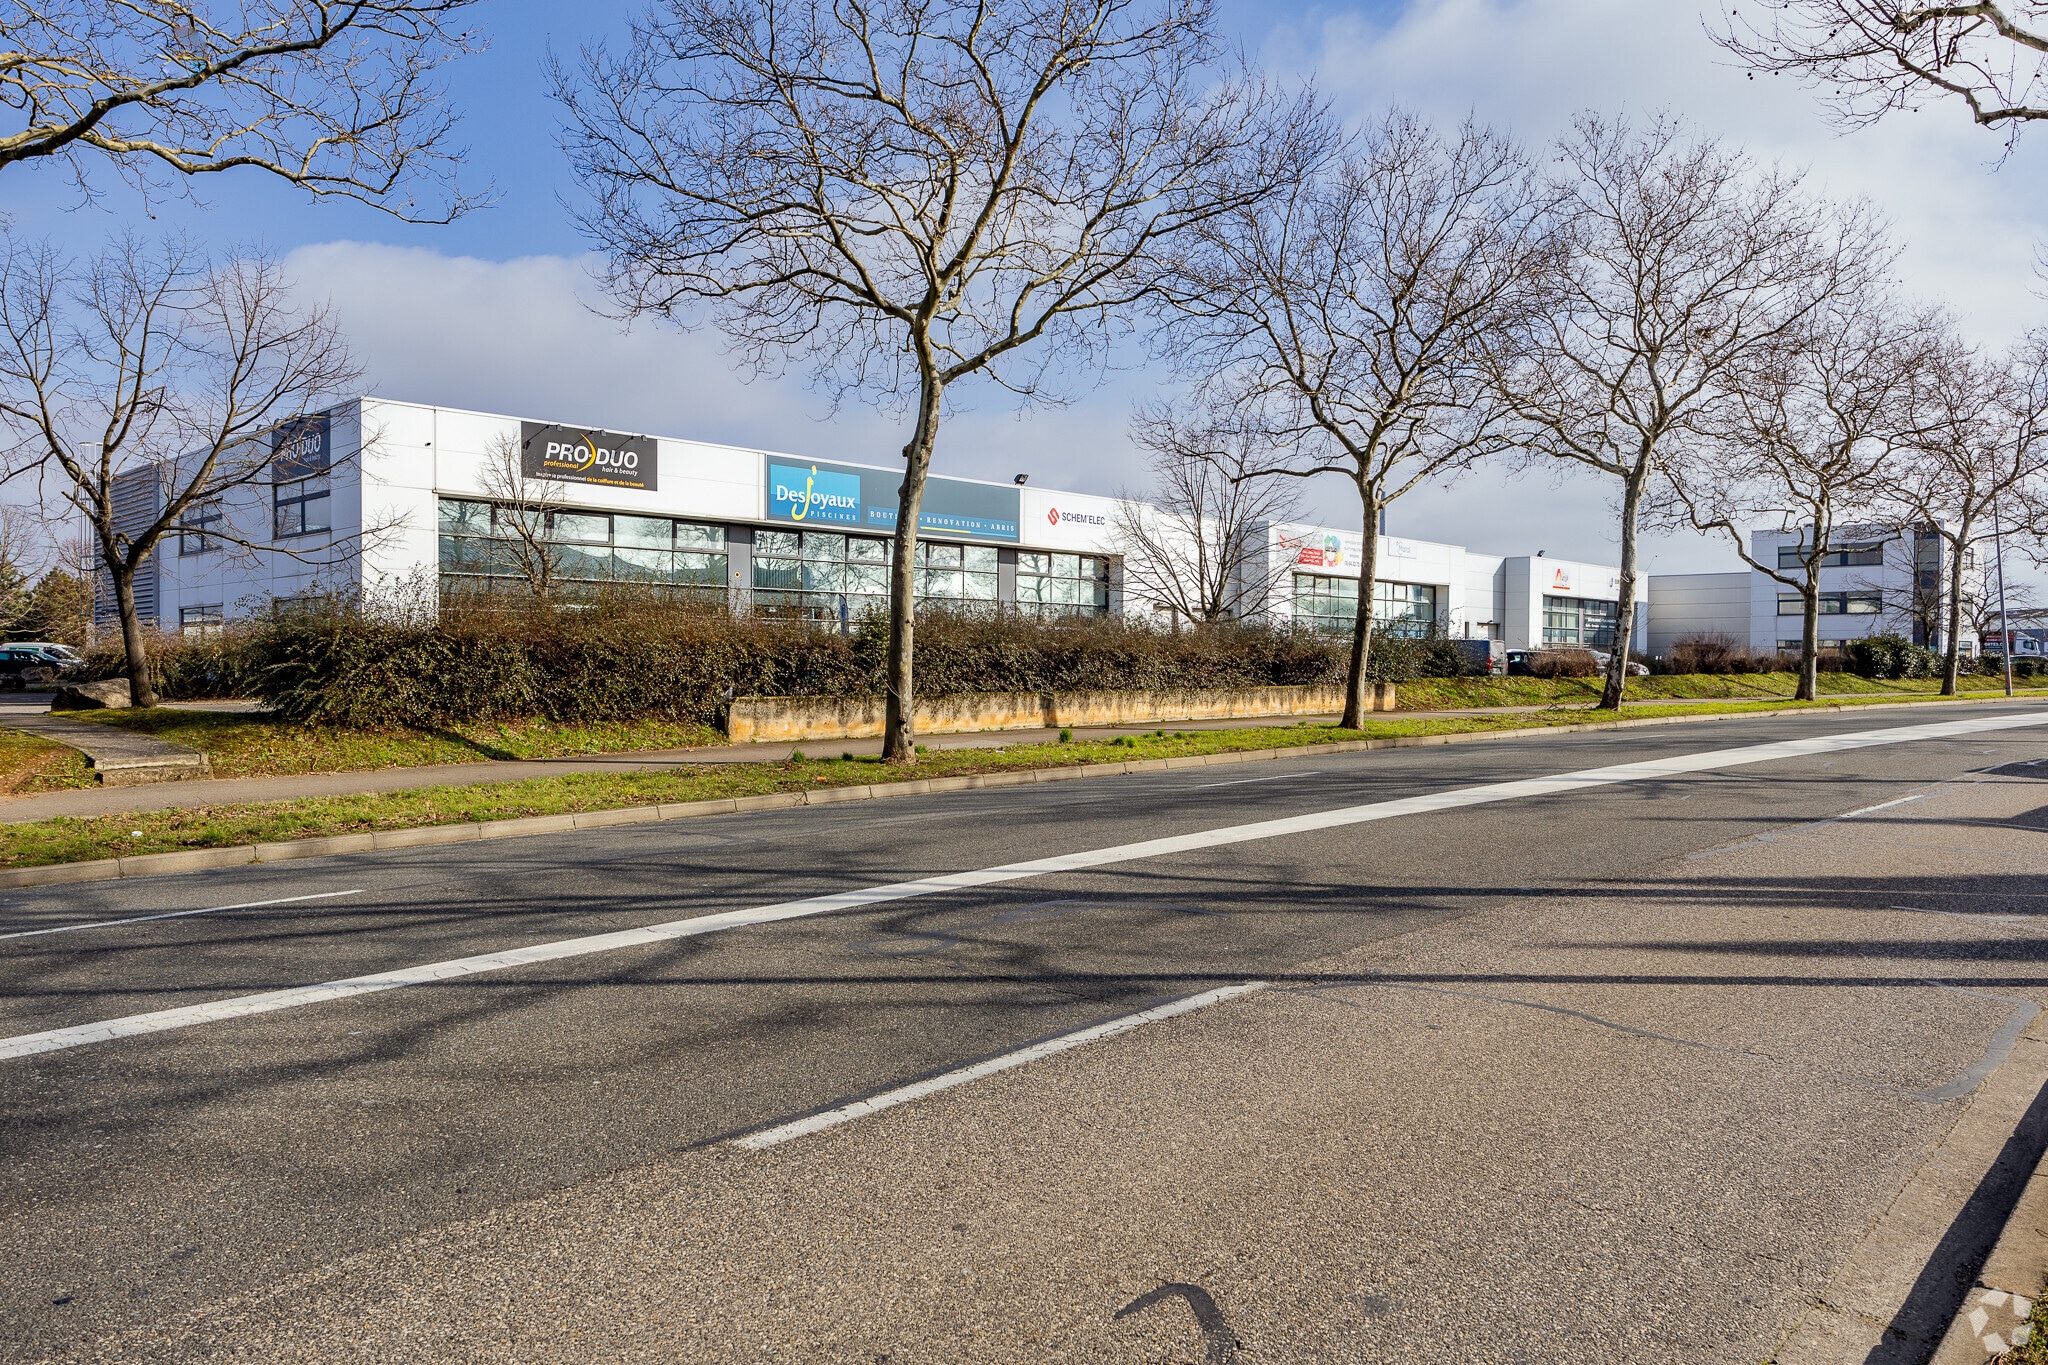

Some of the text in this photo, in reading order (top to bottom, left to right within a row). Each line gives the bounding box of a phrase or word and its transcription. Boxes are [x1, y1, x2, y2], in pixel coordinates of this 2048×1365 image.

[543, 459, 579, 470] professional
[602, 466, 613, 474] hair
[619, 468, 638, 477] beauty
[557, 474, 587, 482] professionnel
[810, 510, 857, 521] PISCINES
[870, 510, 1015, 532] BOUTI RENOVATION ABRIS
